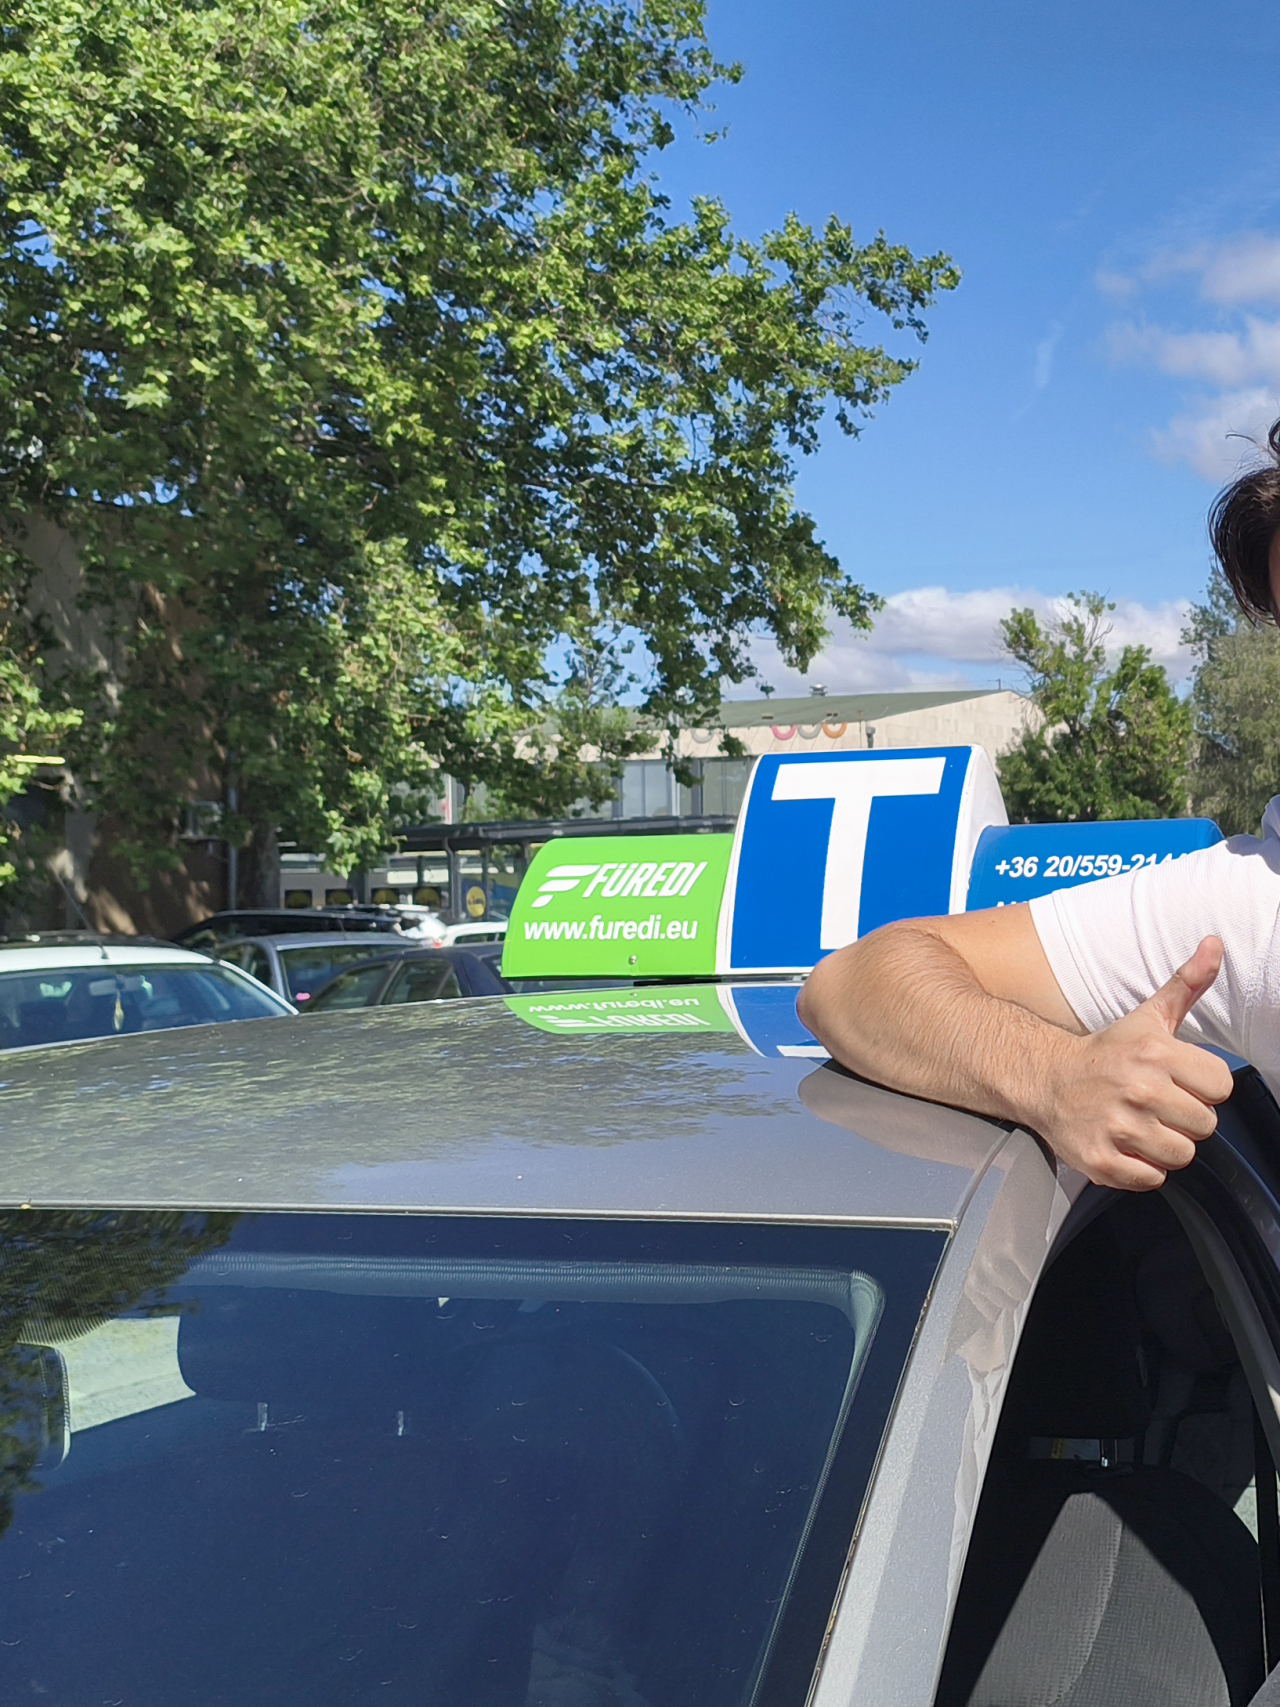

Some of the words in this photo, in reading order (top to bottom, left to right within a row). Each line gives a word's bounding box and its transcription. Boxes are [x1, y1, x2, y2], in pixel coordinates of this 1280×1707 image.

[771, 757, 946, 950] T
[995, 856, 1039, 878] +36
[582, 861, 708, 898] FÜREDI
[523, 914, 698, 940] www.furedi.eu
